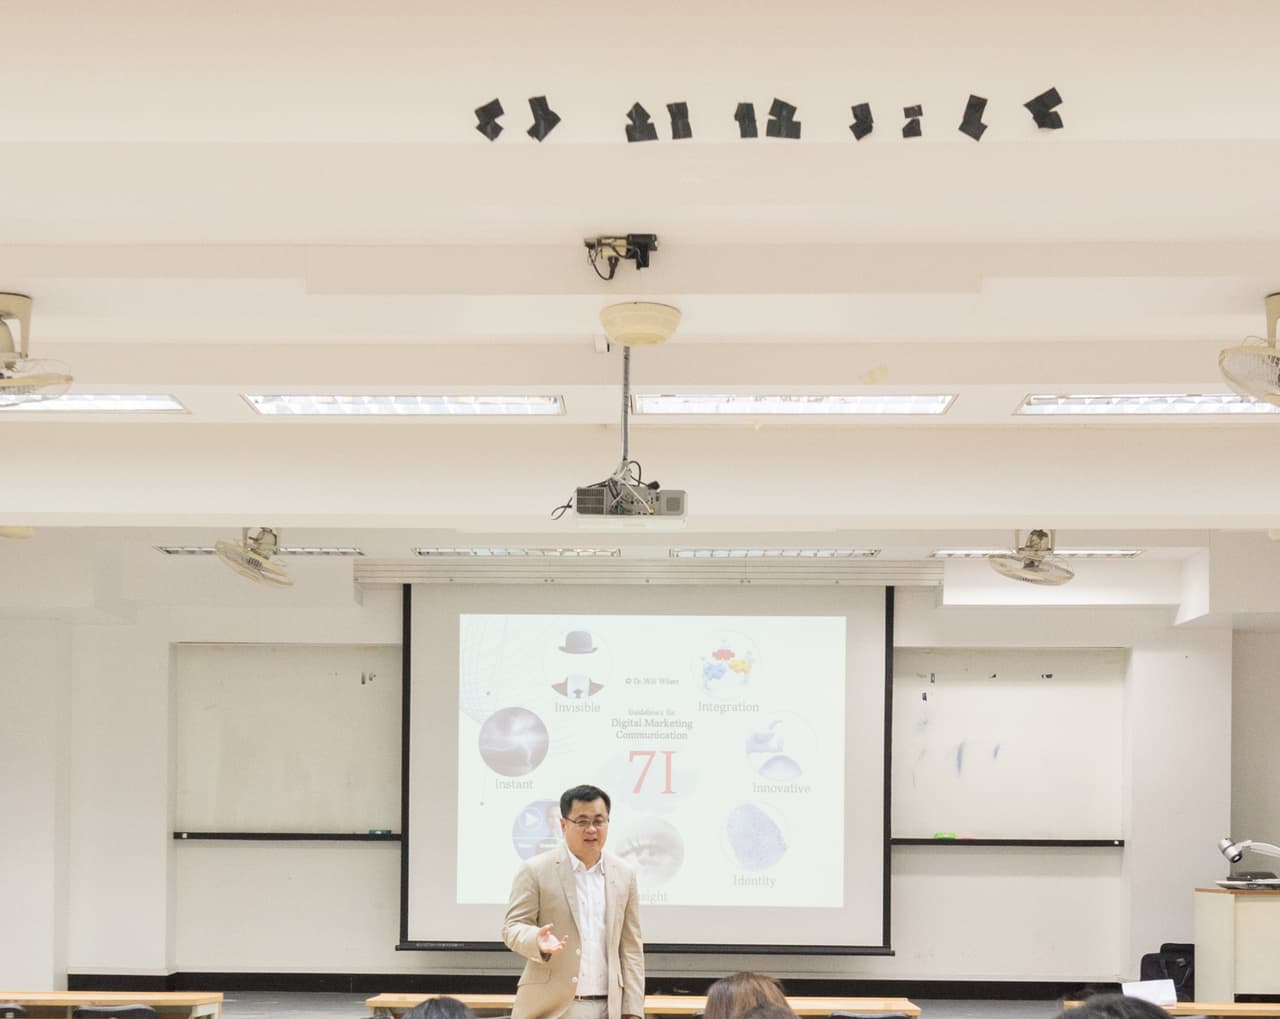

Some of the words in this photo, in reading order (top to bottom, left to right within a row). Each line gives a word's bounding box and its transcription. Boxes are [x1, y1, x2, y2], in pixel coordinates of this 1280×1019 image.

[554, 702, 601, 713] Invisible
[698, 701, 760, 715] Integration
[611, 718, 642, 730] Digital
[644, 718, 694, 730] Marketing
[615, 730, 689, 740] Communication
[495, 779, 534, 790] Instant
[752, 782, 812, 794] Innovative
[732, 875, 777, 888] Identity
